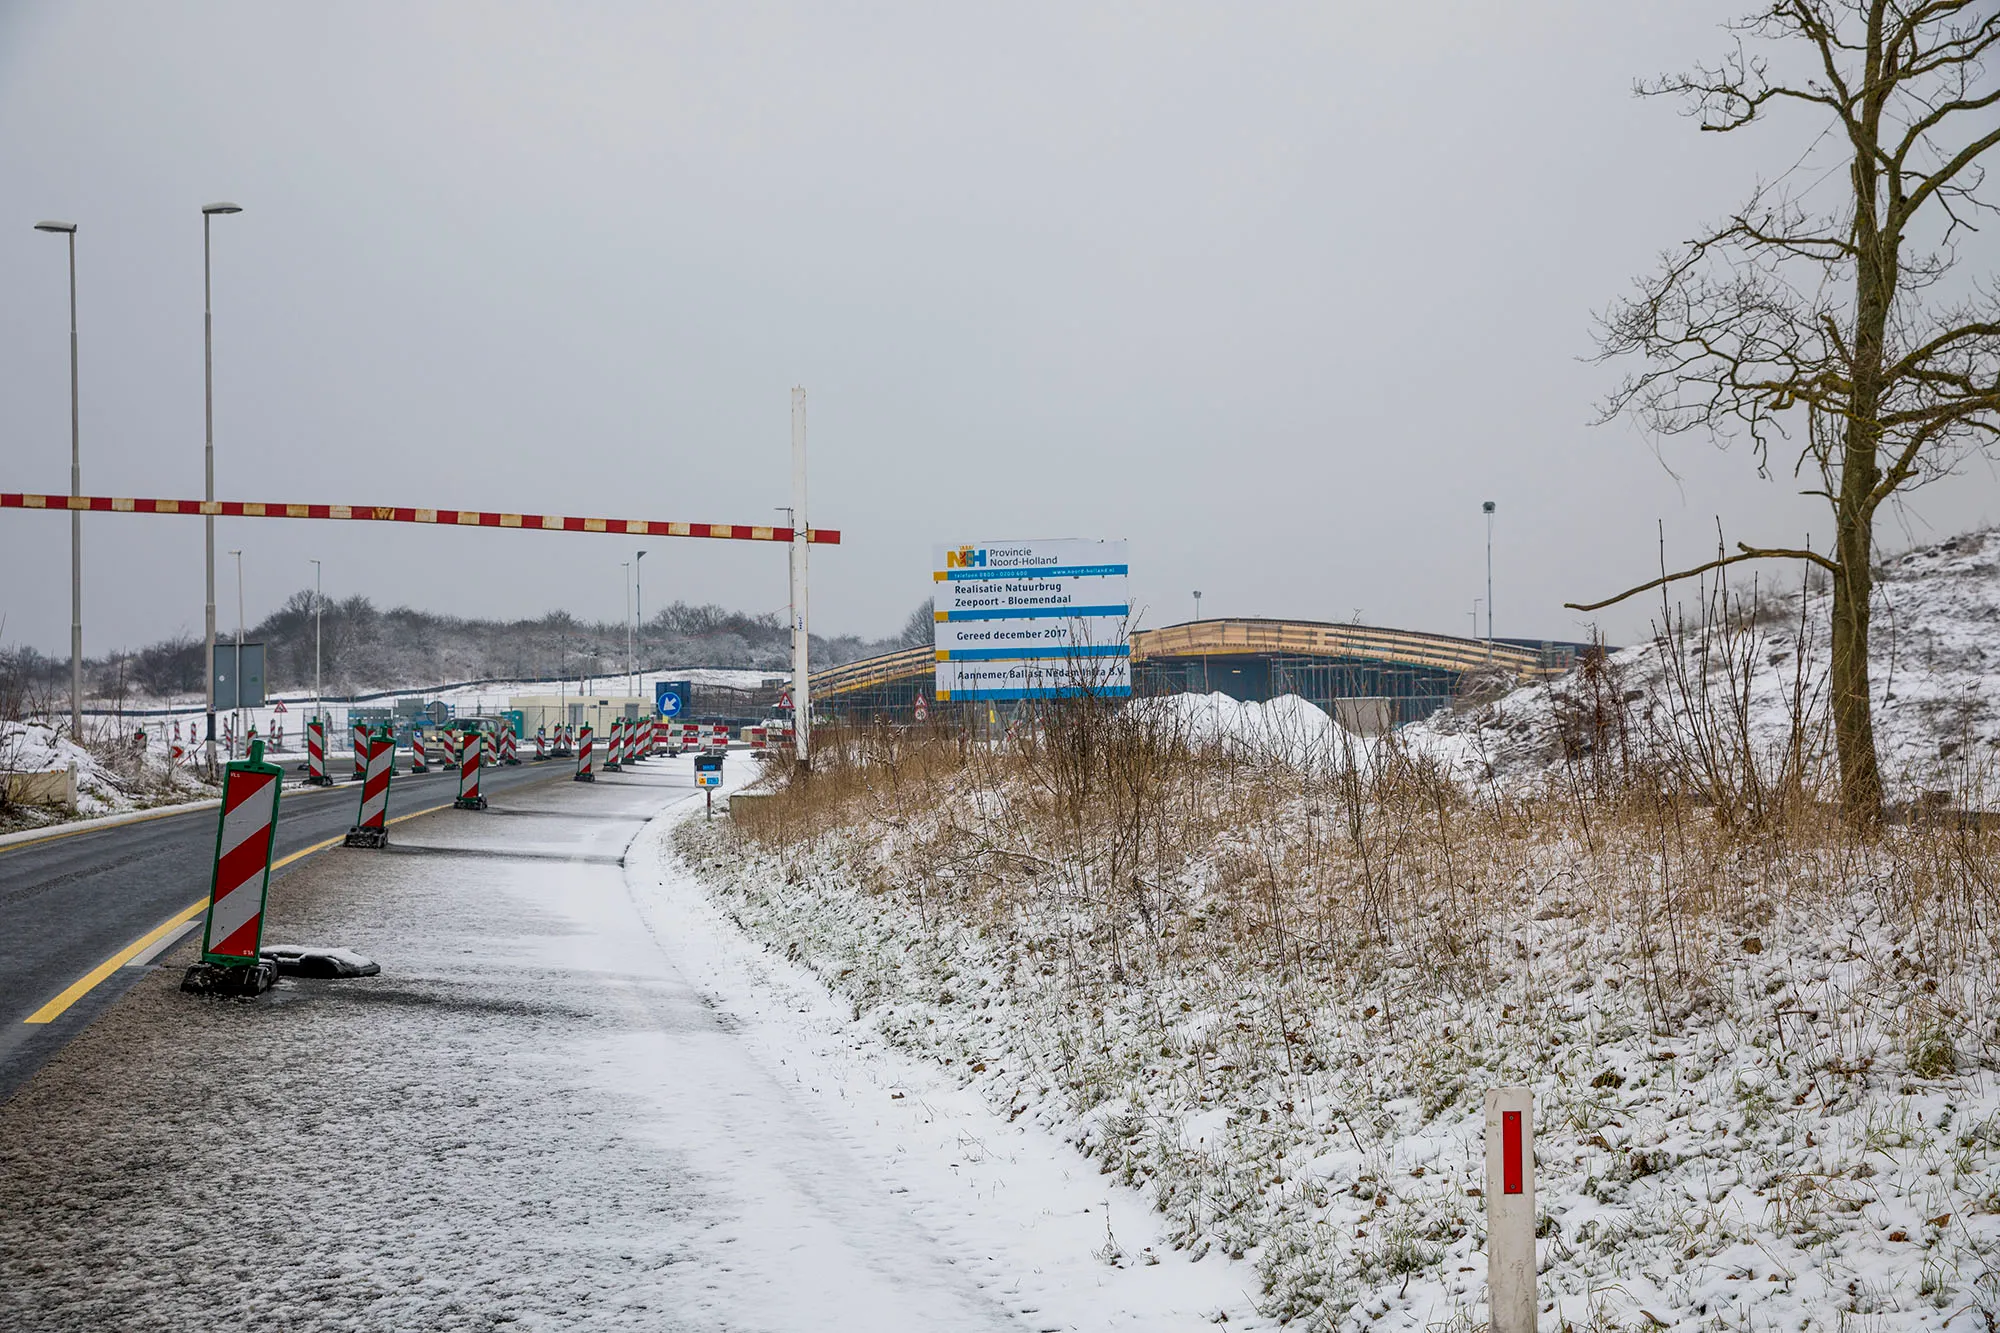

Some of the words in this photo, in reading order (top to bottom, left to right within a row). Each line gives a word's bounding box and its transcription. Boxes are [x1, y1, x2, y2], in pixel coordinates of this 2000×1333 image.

[990, 548, 1032, 557] Provincie
[990, 556, 1058, 567] Noord-Holland
[955, 585, 1002, 594] Realisatie
[1005, 583, 1062, 593] Natuurbrug
[955, 597, 999, 608] Zeepoort
[1008, 594, 1071, 605] Bloemendaal
[957, 630, 991, 641] Gereed
[993, 628, 1042, 640] december
[1044, 629, 1067, 639] 2017
[957, 671, 1007, 680] Aannemer
